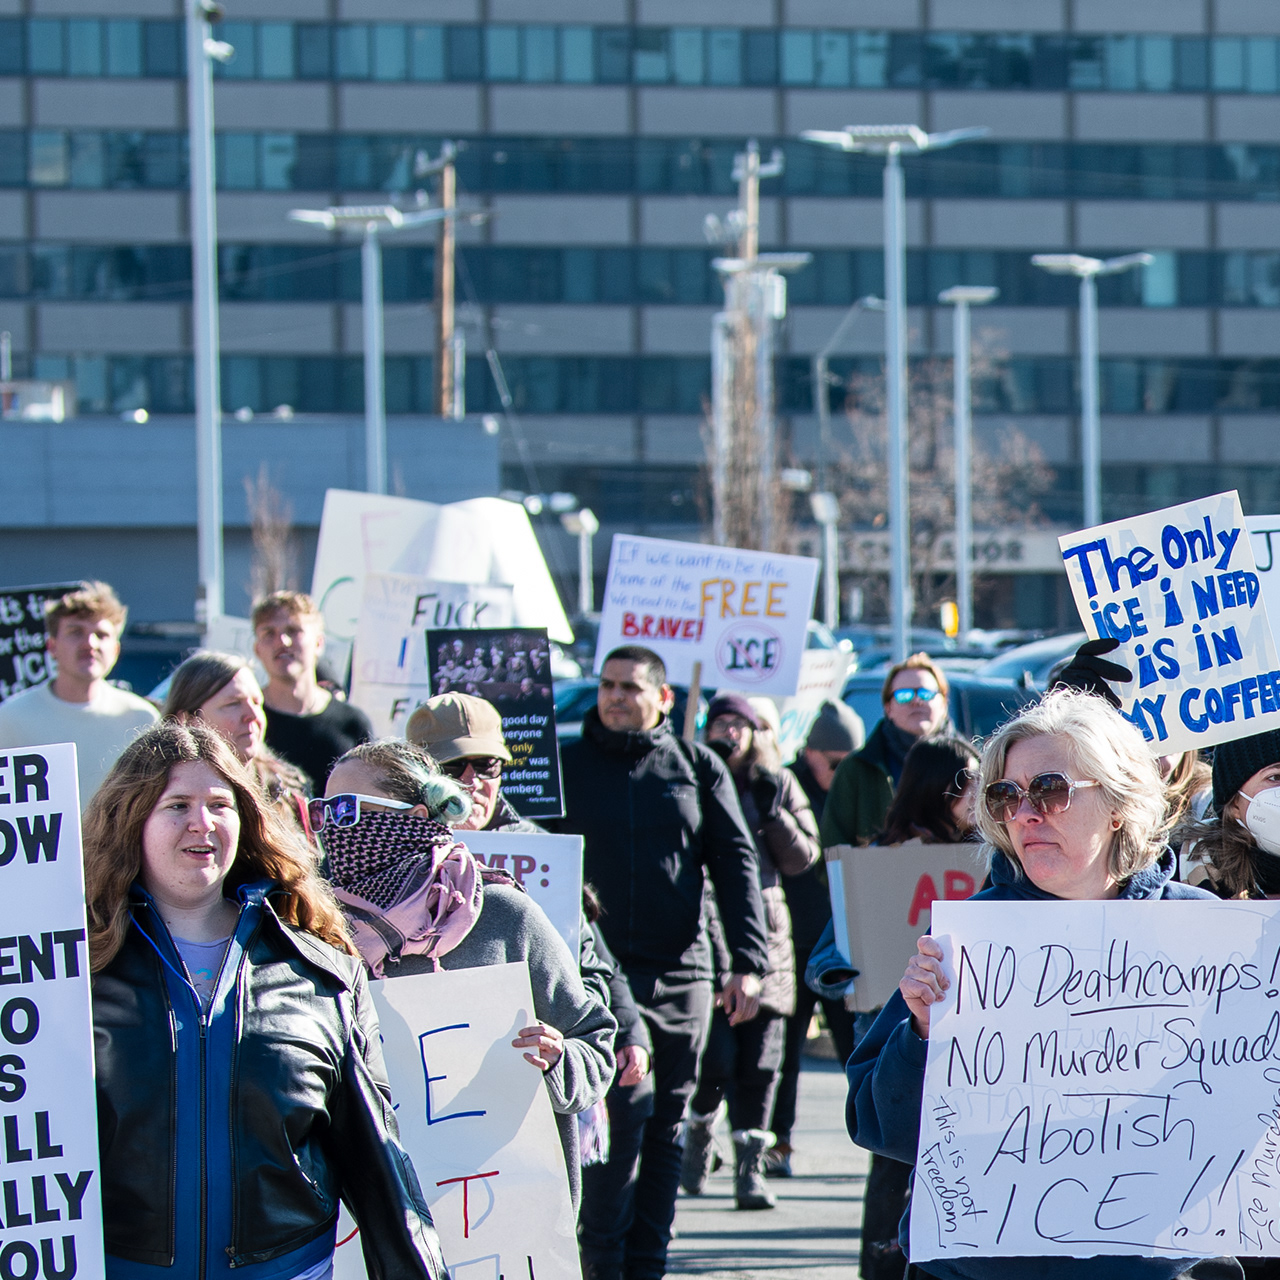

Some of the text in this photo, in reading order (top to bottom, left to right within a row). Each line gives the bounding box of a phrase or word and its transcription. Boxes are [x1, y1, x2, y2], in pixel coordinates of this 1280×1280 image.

[646, 552, 669, 566] we
[675, 553, 711, 569] want
[761, 561, 785, 579] the
[1062, 515, 1241, 600] The Only
[411, 593, 489, 630] FUCK
[700, 577, 788, 619] FREE
[1192, 570, 1261, 621] NEED
[621, 612, 706, 643] BRAVE!
[726, 637, 779, 670] ICE
[502, 714, 548, 728] good day
[1119, 693, 1168, 742] MY
[512, 742, 534, 753] only
[529, 756, 550, 766] was
[510, 769, 550, 780] defense
[956, 943, 1015, 1014] NO
[947, 1026, 1005, 1088] NO
[1023, 1029, 1159, 1083] Murder
[984, 1096, 1195, 1176] Abolish
[932, 1095, 988, 1223] This is not
[0, 1170, 94, 1230] LLY
